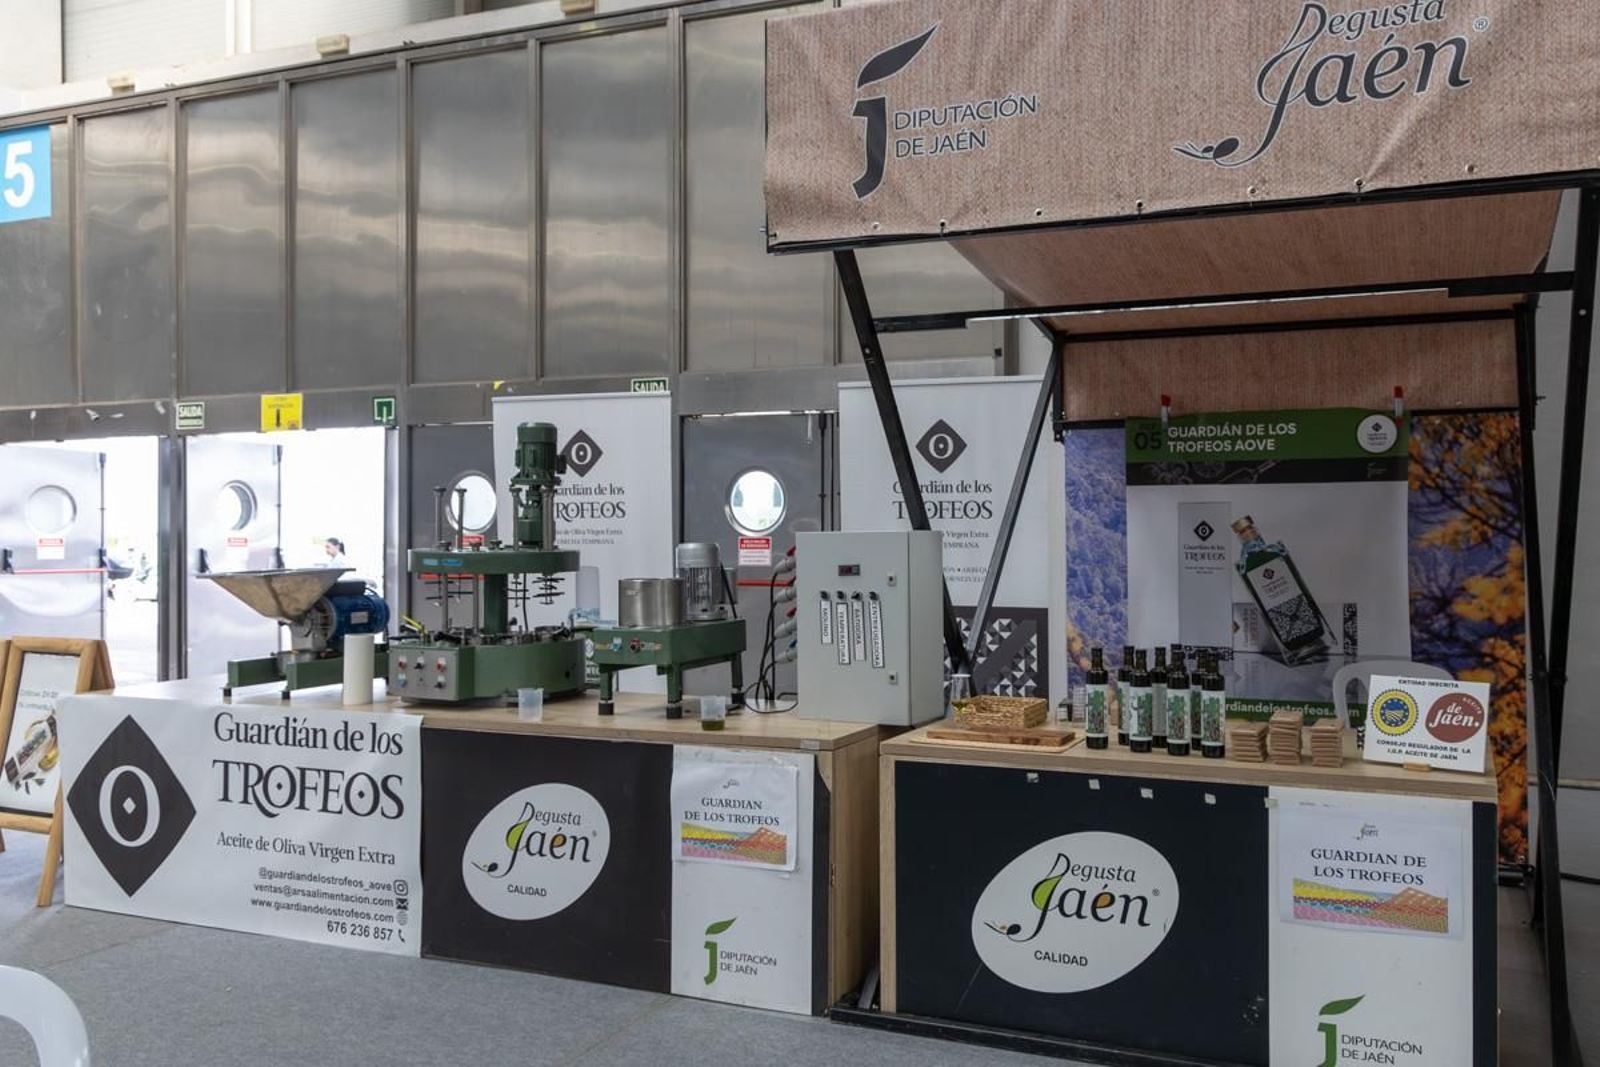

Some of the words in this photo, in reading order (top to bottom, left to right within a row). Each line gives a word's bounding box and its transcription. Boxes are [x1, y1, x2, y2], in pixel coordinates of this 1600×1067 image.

[1284, 0, 1446, 51] Degusta
[1214, 33, 1472, 166] Jaén
[895, 95, 1037, 130] DIPUTACIÓN
[896, 138, 924, 158] DE
[929, 130, 986, 155] JAÉN
[3, 140, 35, 208] 5
[1134, 431, 1162, 449] 05
[1168, 422, 1243, 438] GUARDIÁN
[1246, 424, 1266, 436] DE
[1269, 423, 1297, 435] LOS
[1168, 440, 1232, 453] TROFEOS
[1234, 439, 1275, 452] AOVE
[556, 483, 593, 496] ardián
[594, 483, 607, 496] de
[610, 483, 625, 496] los
[893, 480, 953, 494] Grdián
[956, 480, 971, 494] de
[974, 480, 992, 494] los
[556, 501, 626, 523] ROFEOS
[892, 500, 993, 520] TOFEOS
[1447, 703, 1461, 713] de
[214, 711, 328, 750] Guardián
[333, 721, 364, 752] de
[370, 722, 404, 756] los
[1376, 740, 1406, 748] CONSEJO
[1408, 742, 1448, 751] REGULADOR
[212, 759, 405, 819] TROFEOS
[519, 802, 582, 826] Degusta
[701, 797, 763, 811] GUARDIAN
[684, 810, 701, 821] DE
[704, 811, 725, 822] LOS
[726, 813, 780, 826] TROFEOS
[217, 831, 254, 850] Aceite
[255, 835, 270, 851] de
[273, 837, 306, 856] Oliva
[308, 841, 355, 863] Virgen
[358, 846, 396, 865] Extra
[488, 820, 591, 878] Jaén
[1311, 848, 1398, 866] GUARDIAN
[1403, 855, 1427, 868] DE
[1046, 853, 1136, 883] Degusta
[1313, 865, 1344, 878] LOS
[1347, 867, 1424, 886] TROFEOS
[259, 867, 392, 891] @guardiandelostrofeos_aove
[253, 883, 394, 907] ventas@arsaalimentacion.com
[507, 884, 547, 897] CALIDAD
[251, 898, 394, 923] www.guardiandelostrofeos.com
[1007, 873, 1150, 942] Jaén
[327, 920, 348, 935] 676
[350, 923, 370, 938] 236
[373, 927, 393, 941] 857
[721, 962, 733, 971] DE
[734, 964, 758, 976] JAÉN
[1034, 950, 1088, 967] CALIDAD
[1341, 1034, 1423, 1055] DIPUTACIÓN
[1342, 1048, 1359, 1060] DE
[1363, 1052, 1395, 1065] JAÉN
